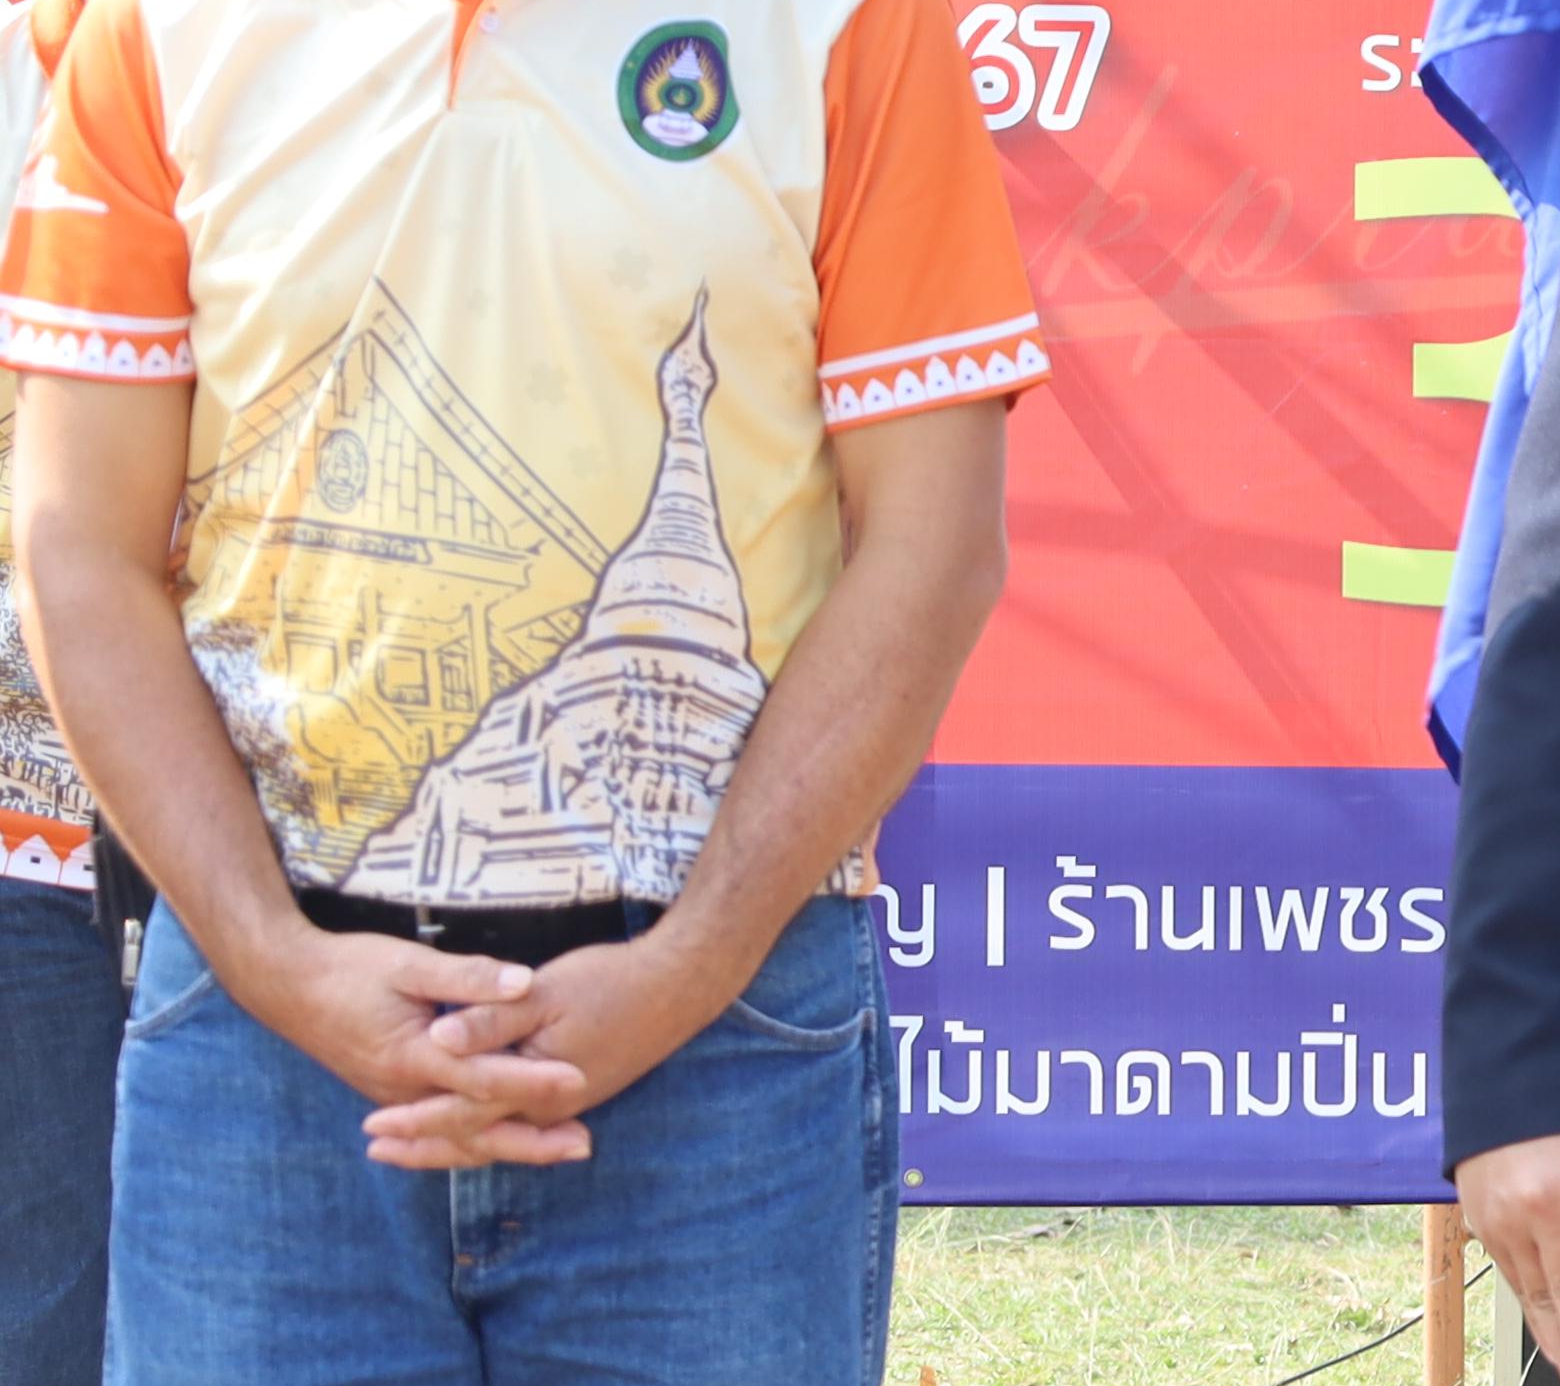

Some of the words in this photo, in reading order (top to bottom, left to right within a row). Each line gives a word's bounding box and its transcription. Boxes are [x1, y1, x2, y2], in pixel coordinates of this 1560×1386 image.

[957, 3, 1112, 131] 67
[889, 1004, 1427, 1118] ไม้มาดามปิ่น
